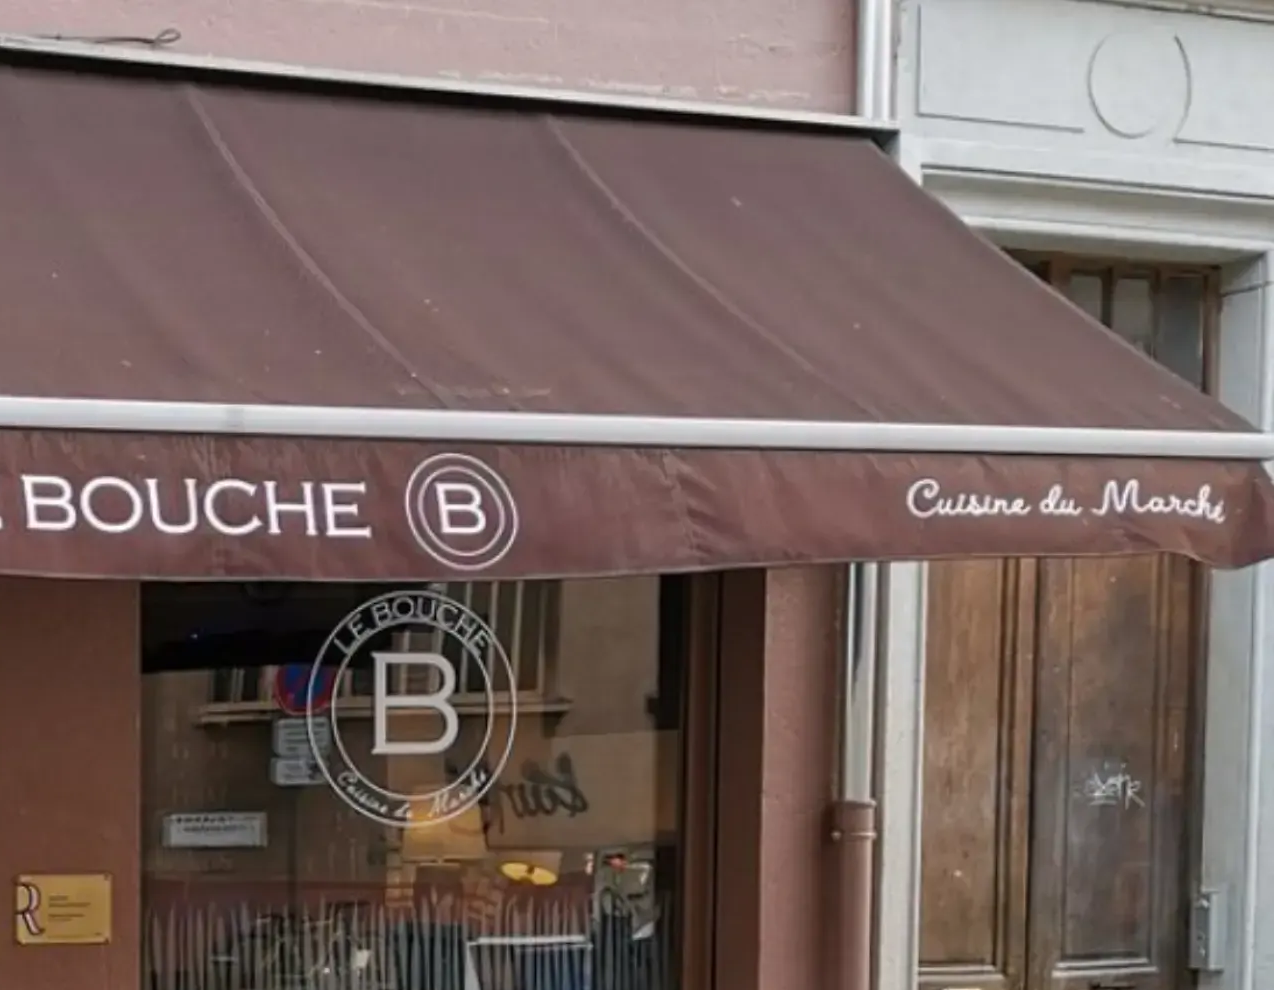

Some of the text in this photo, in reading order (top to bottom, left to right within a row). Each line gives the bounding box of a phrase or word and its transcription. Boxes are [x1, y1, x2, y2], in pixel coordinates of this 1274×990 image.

[20, 474, 372, 538] BOUCHE
[434, 482, 487, 535] B
[906, 478, 1032, 518] Cuisine
[1039, 483, 1083, 517] du
[333, 597, 494, 658] LE BOUCHE
[371, 651, 460, 755] B
